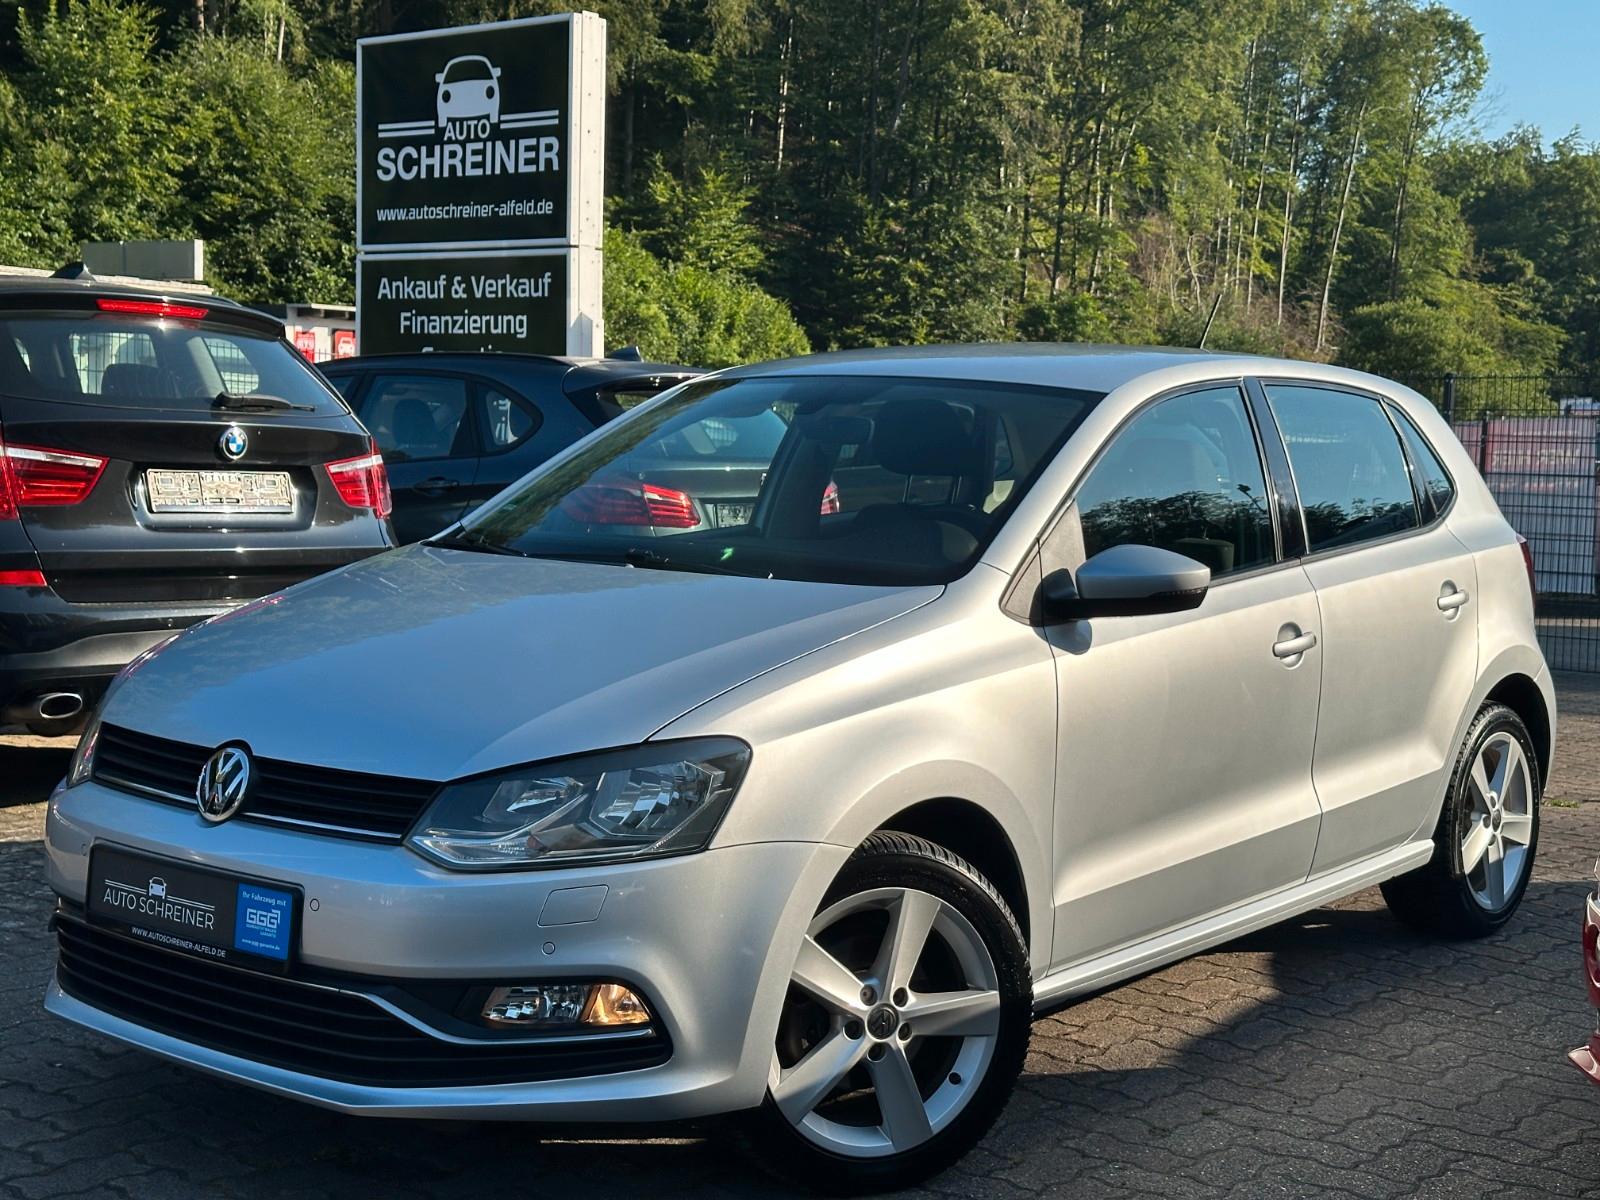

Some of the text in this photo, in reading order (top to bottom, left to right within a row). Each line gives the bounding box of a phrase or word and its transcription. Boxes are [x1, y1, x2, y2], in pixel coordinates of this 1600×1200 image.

[443, 119, 490, 141] AUTO
[376, 136, 560, 182] SCHREINER
[376, 199, 554, 222] www.autoschreiner-alfeld.de
[377, 272, 552, 300] Ankauf & Verkauf
[400, 310, 528, 338] Finanzierung
[103, 887, 137, 910] AUTO
[138, 896, 215, 931] SCHREINER
[251, 892, 276, 906] Fahrzeug
[131, 926, 226, 958] WWW.AUTOSCHREINER-ALFELD.DE
